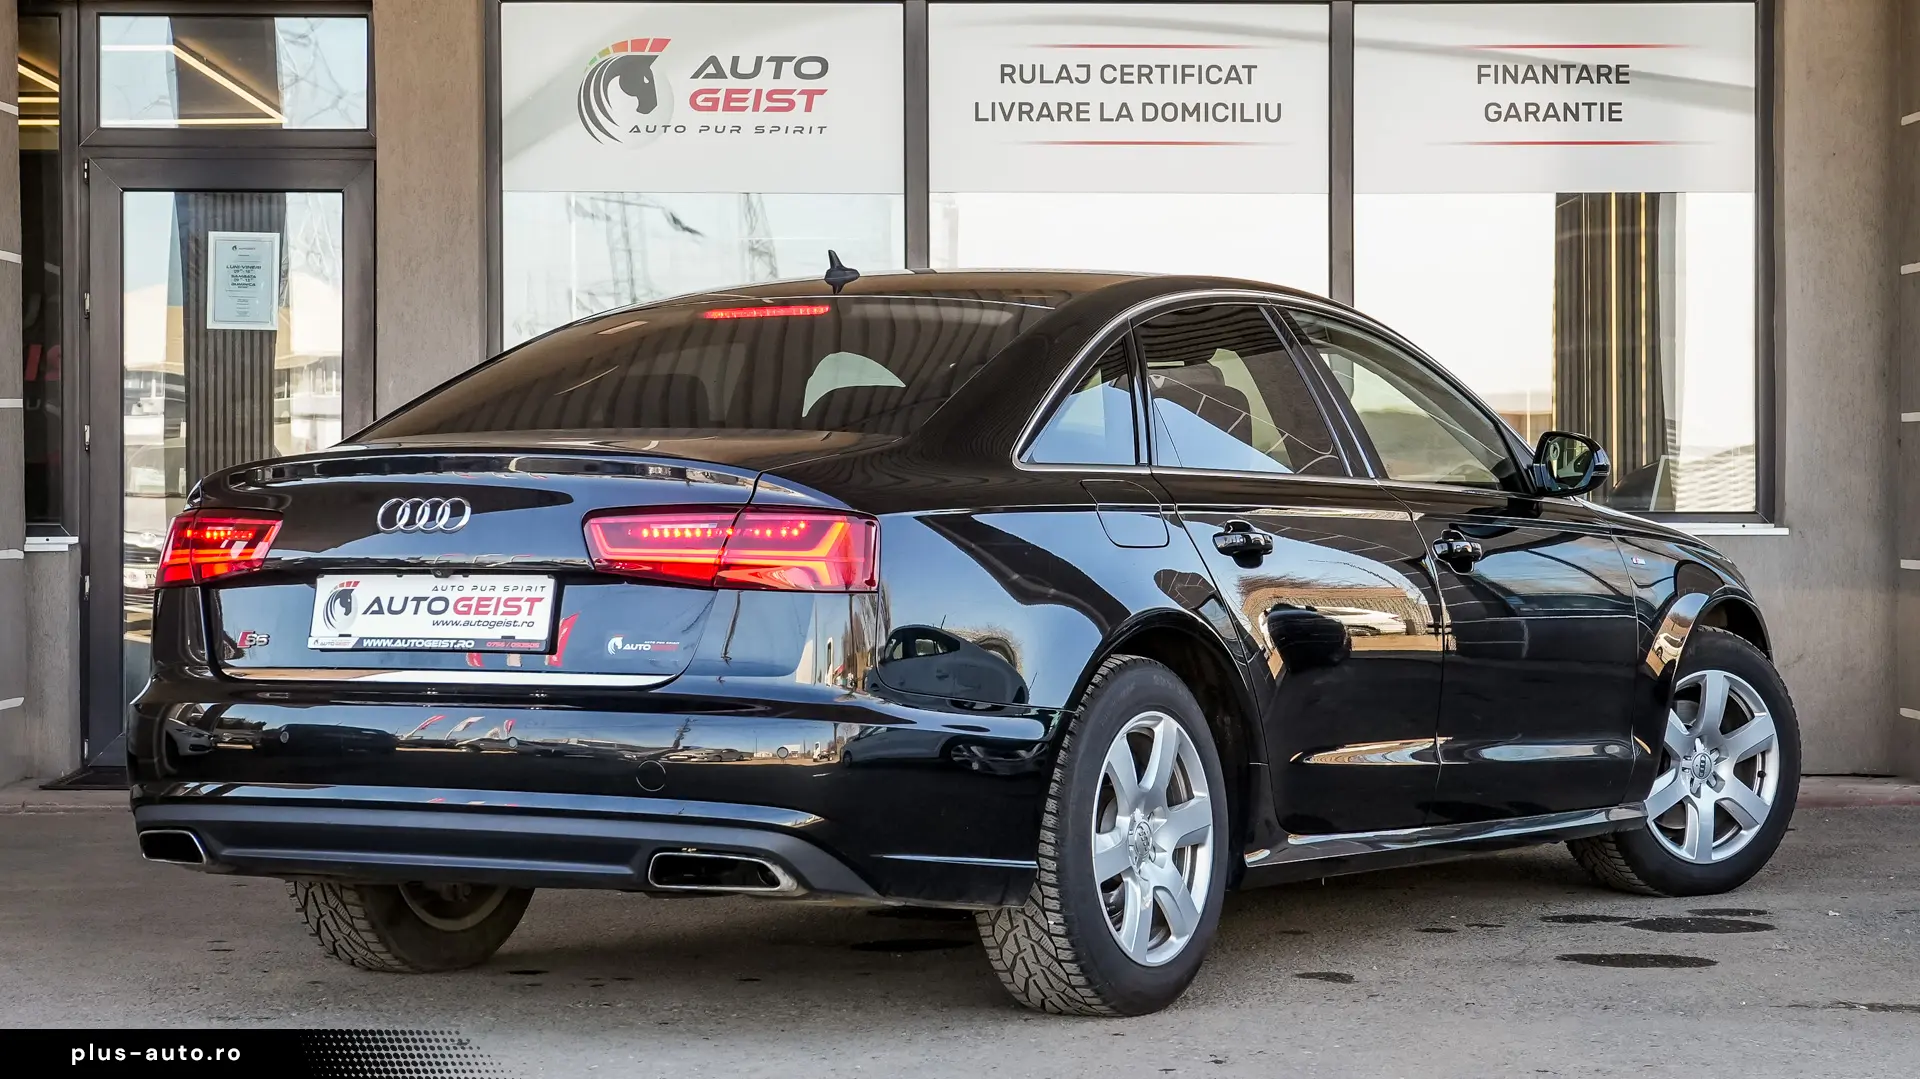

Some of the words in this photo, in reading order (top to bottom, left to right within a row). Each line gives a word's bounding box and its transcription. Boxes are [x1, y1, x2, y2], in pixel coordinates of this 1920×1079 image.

[689, 55, 829, 80] AUTO
[1000, 63, 1091, 84] RULAJ
[1099, 64, 1258, 85] CERTIFICAT
[1477, 64, 1630, 84] FINANTARE
[689, 88, 828, 113] GEIST
[974, 101, 1091, 122] LIVRARE
[1099, 102, 1134, 122] LA
[1142, 102, 1282, 123] DOMICILIU
[1484, 102, 1623, 122] GARANTIE
[629, 124, 687, 134] AUTO
[699, 125, 742, 134] PUR
[754, 125, 828, 135] SPIRIT
[503, 585, 547, 593] SPIRIT
[361, 596, 449, 616] AUTO
[453, 596, 545, 617] GEIST
[432, 619, 535, 629] www.autogeist.ro
[243, 632, 270, 647] S6
[362, 638, 476, 649] WWW.AUTOGEIST.RO
[623, 643, 652, 651] AUTO
